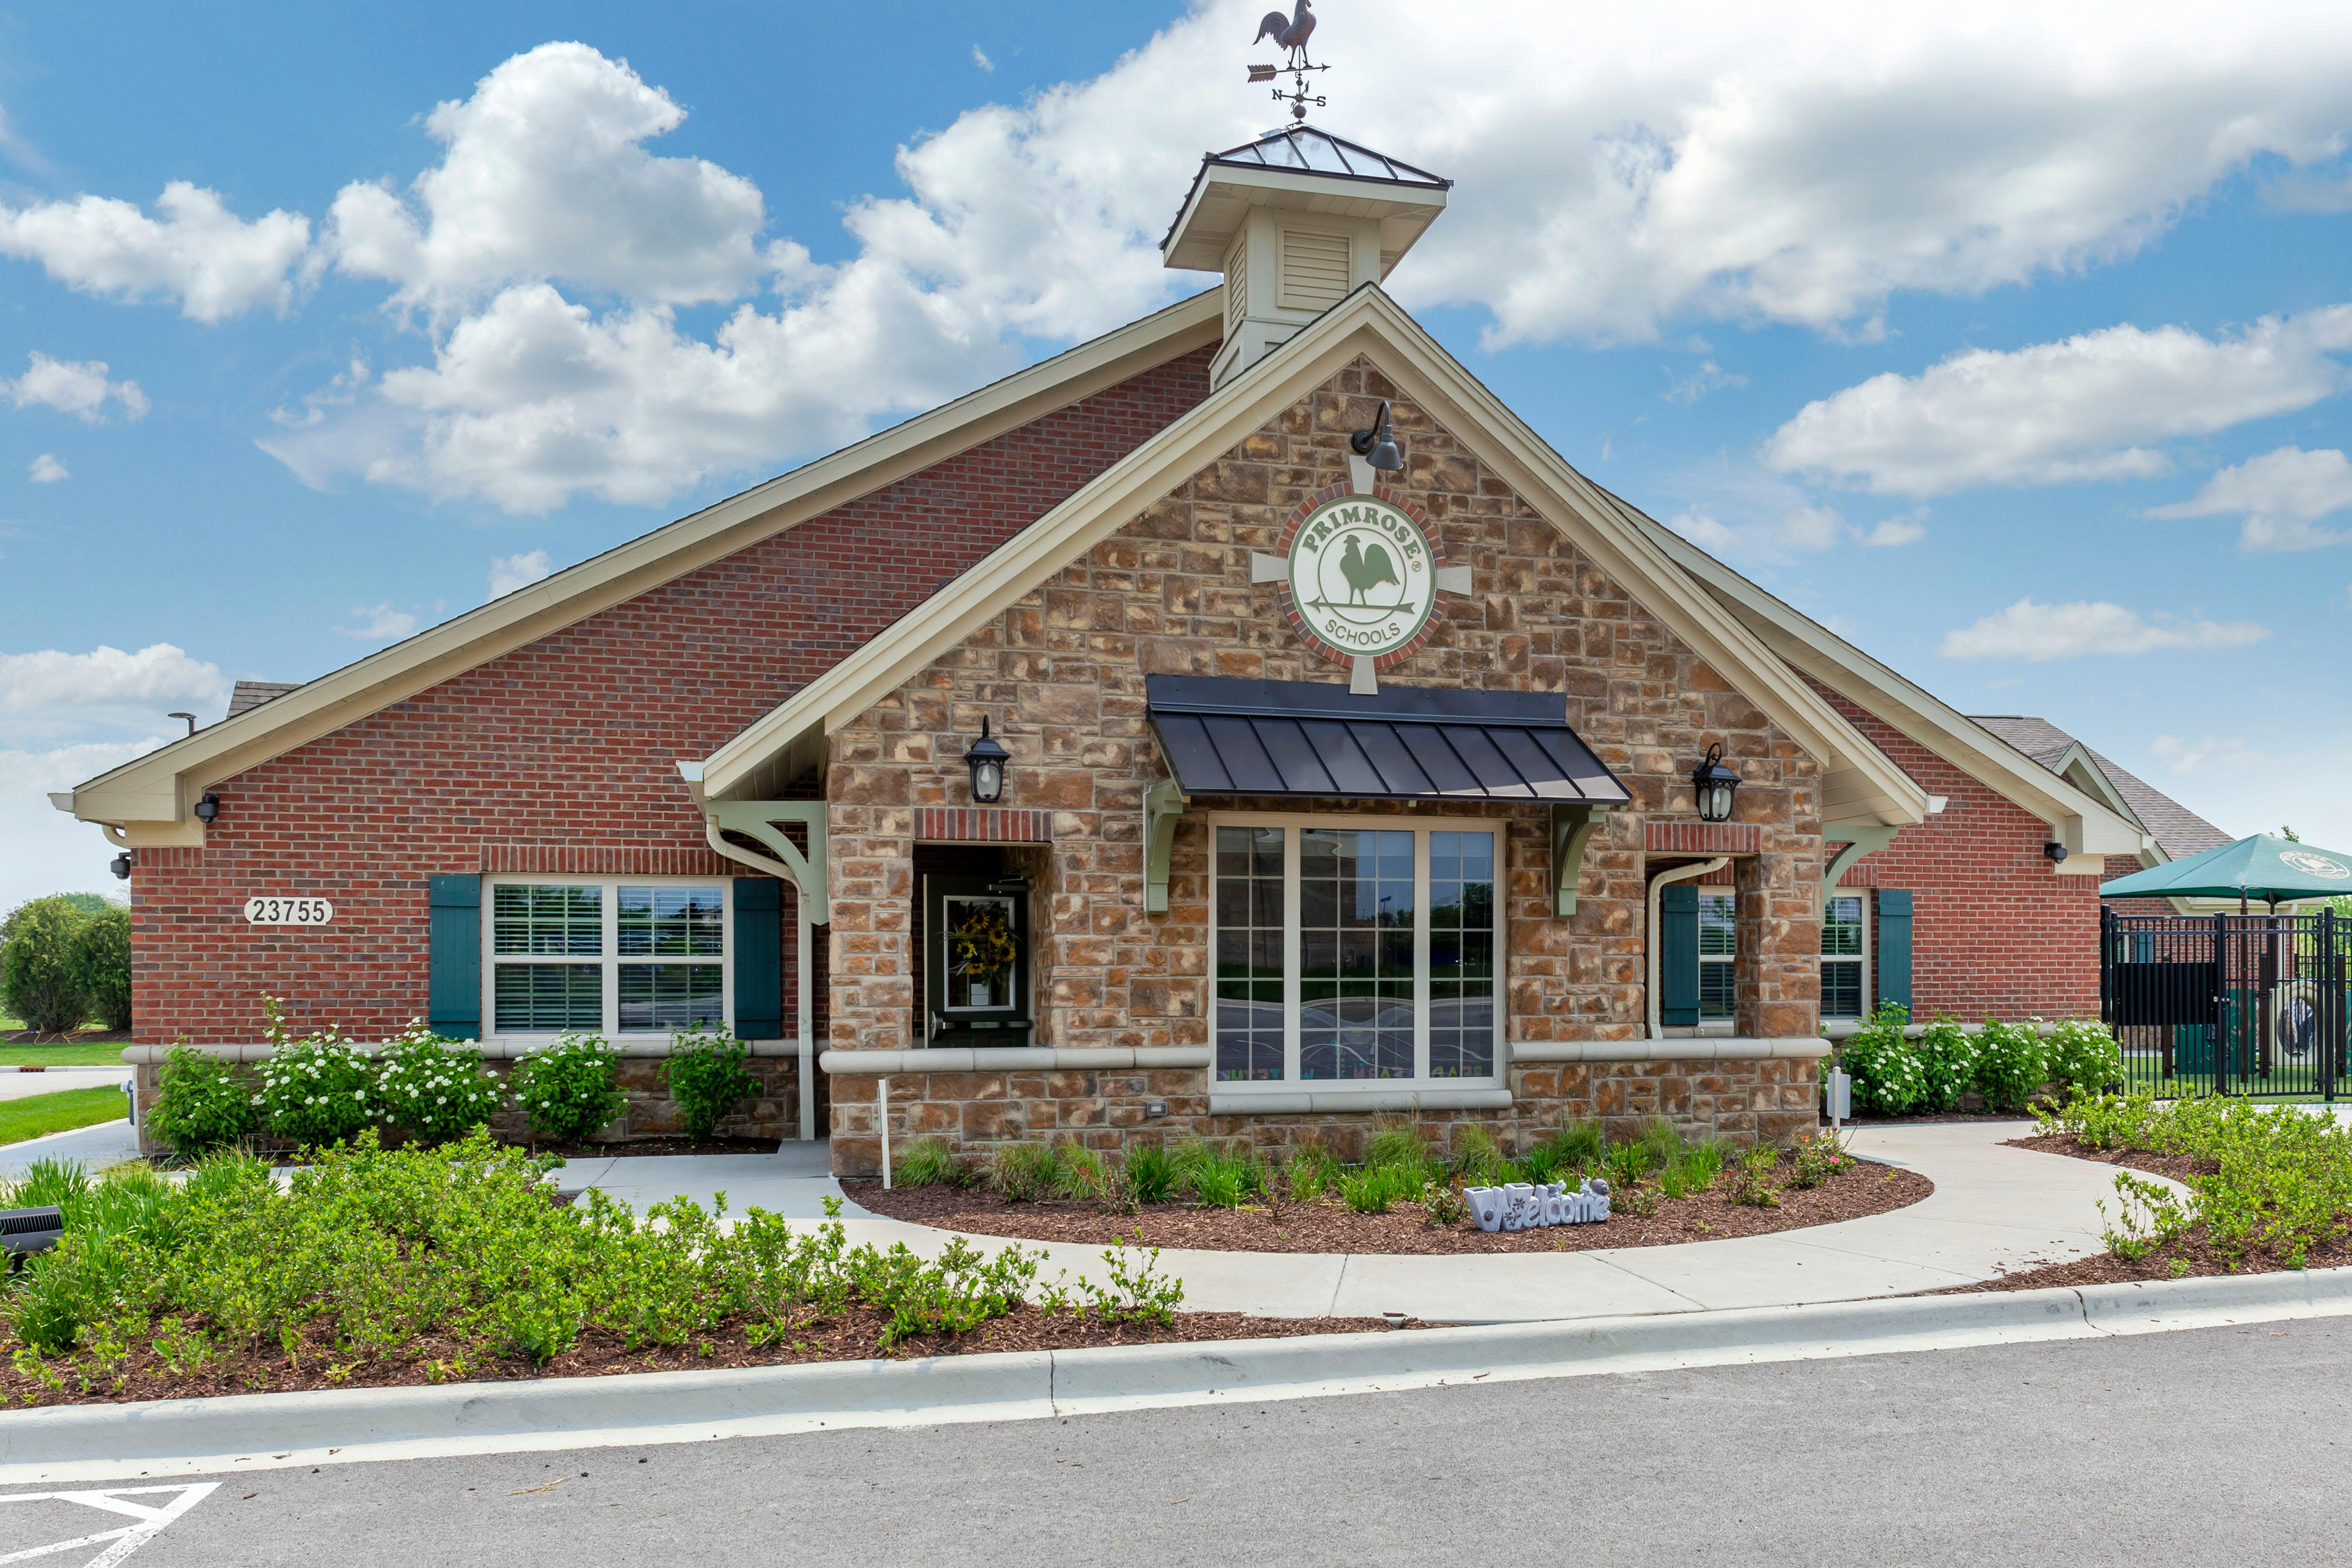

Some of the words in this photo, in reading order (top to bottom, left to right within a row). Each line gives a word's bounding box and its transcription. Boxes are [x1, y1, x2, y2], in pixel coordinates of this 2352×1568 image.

[1272, 89, 1282, 101] N
[1317, 96, 1326, 107] S
[1325, 619, 1400, 645] SCHOOLS
[253, 900, 325, 922] 23755
[1463, 1182, 1611, 1232] Welcome
